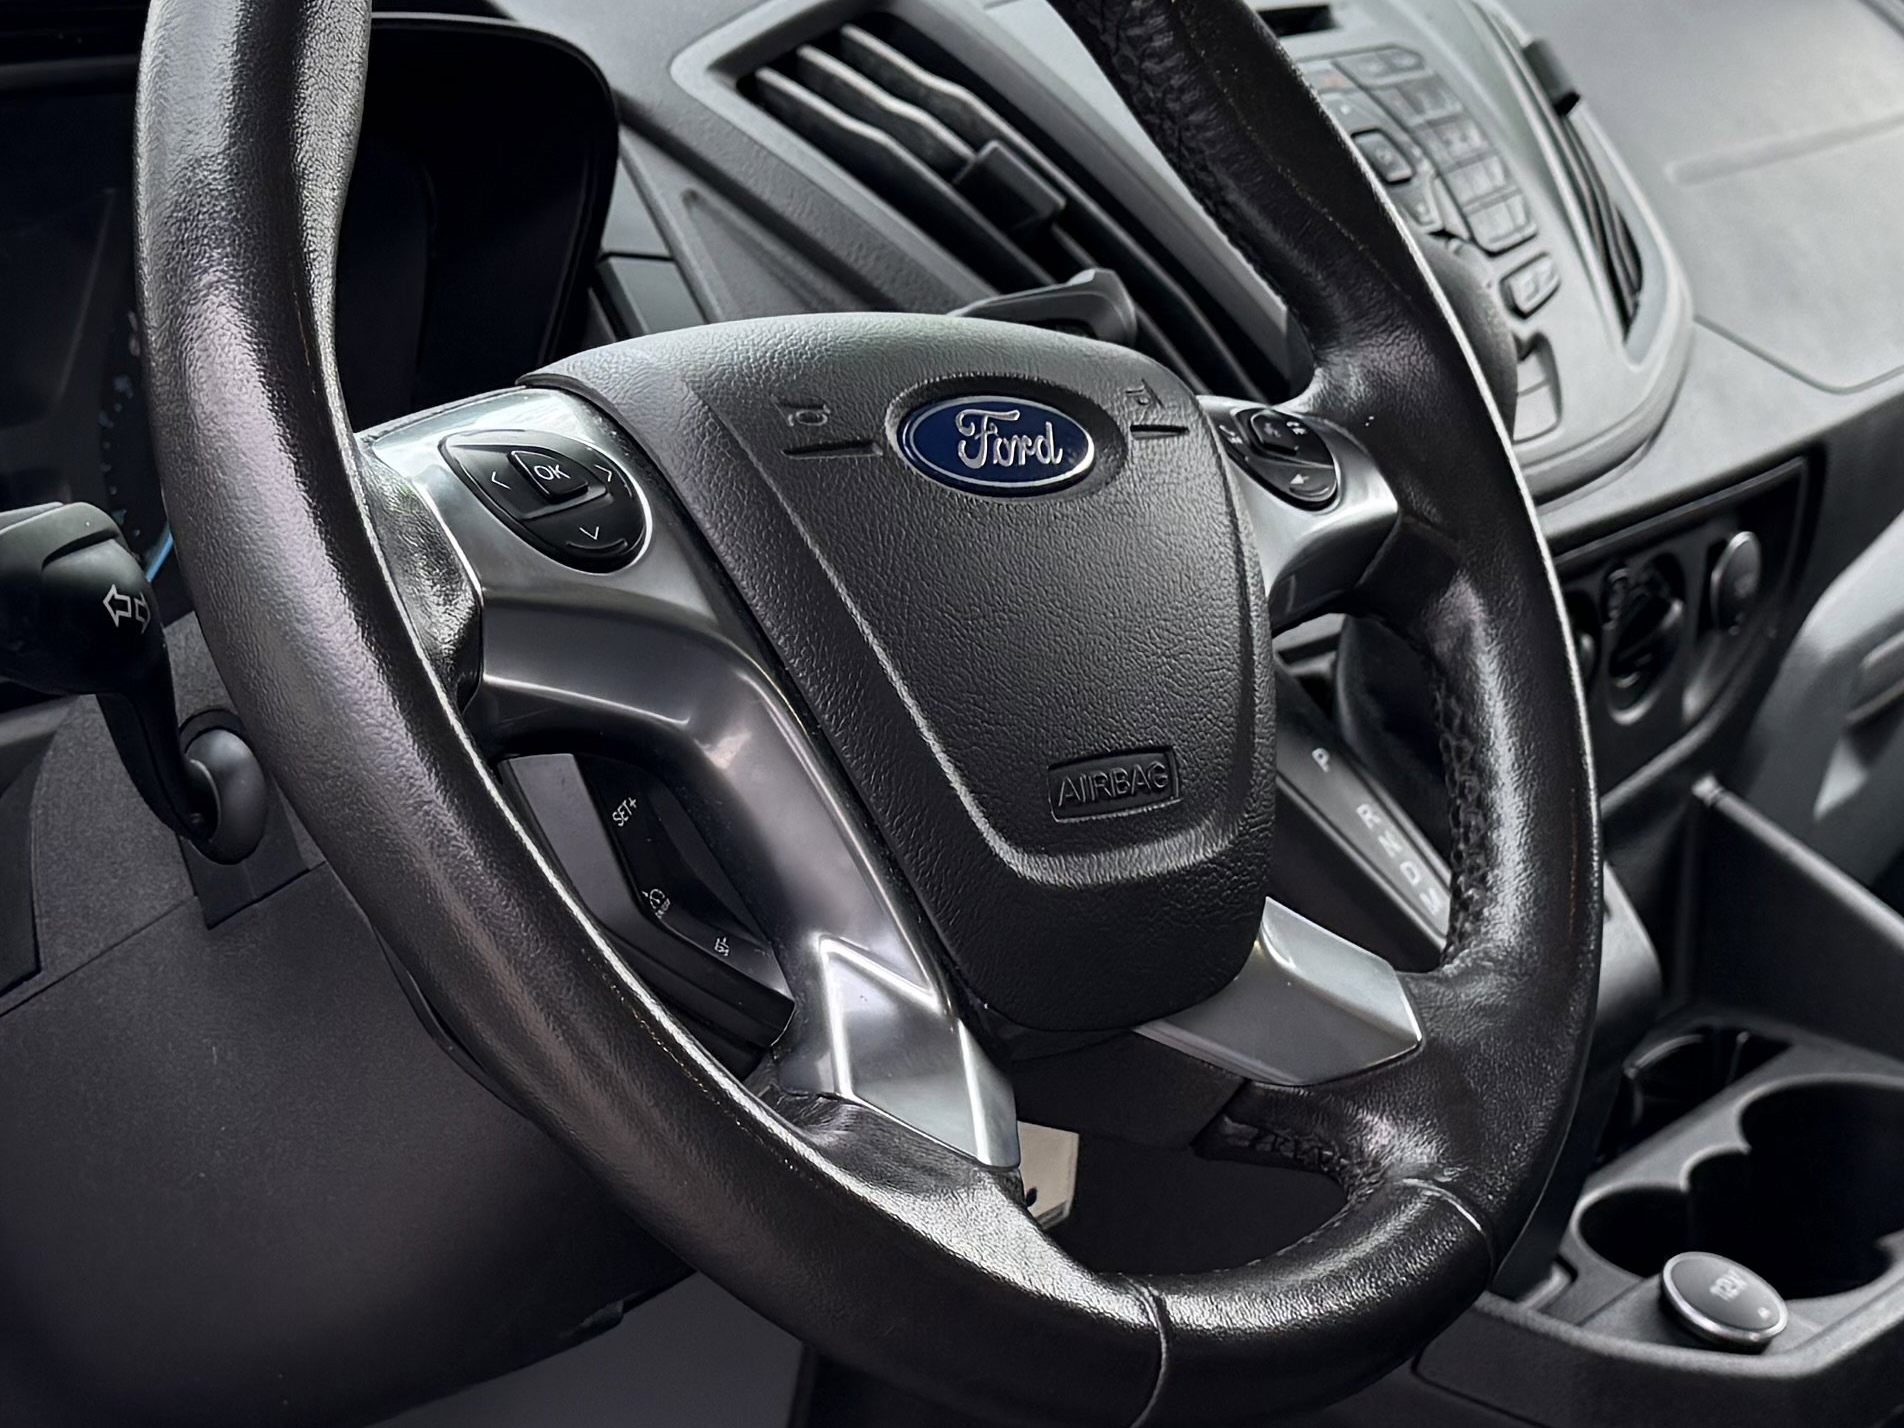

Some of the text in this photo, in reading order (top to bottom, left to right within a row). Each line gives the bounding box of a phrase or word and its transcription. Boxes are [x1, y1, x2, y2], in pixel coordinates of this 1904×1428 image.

[955, 409, 1063, 468] Ford
[534, 464, 570, 482] OK
[1311, 747, 1330, 772] P
[1058, 761, 1169, 808] AIRBAG
[1356, 803, 1381, 831] R
